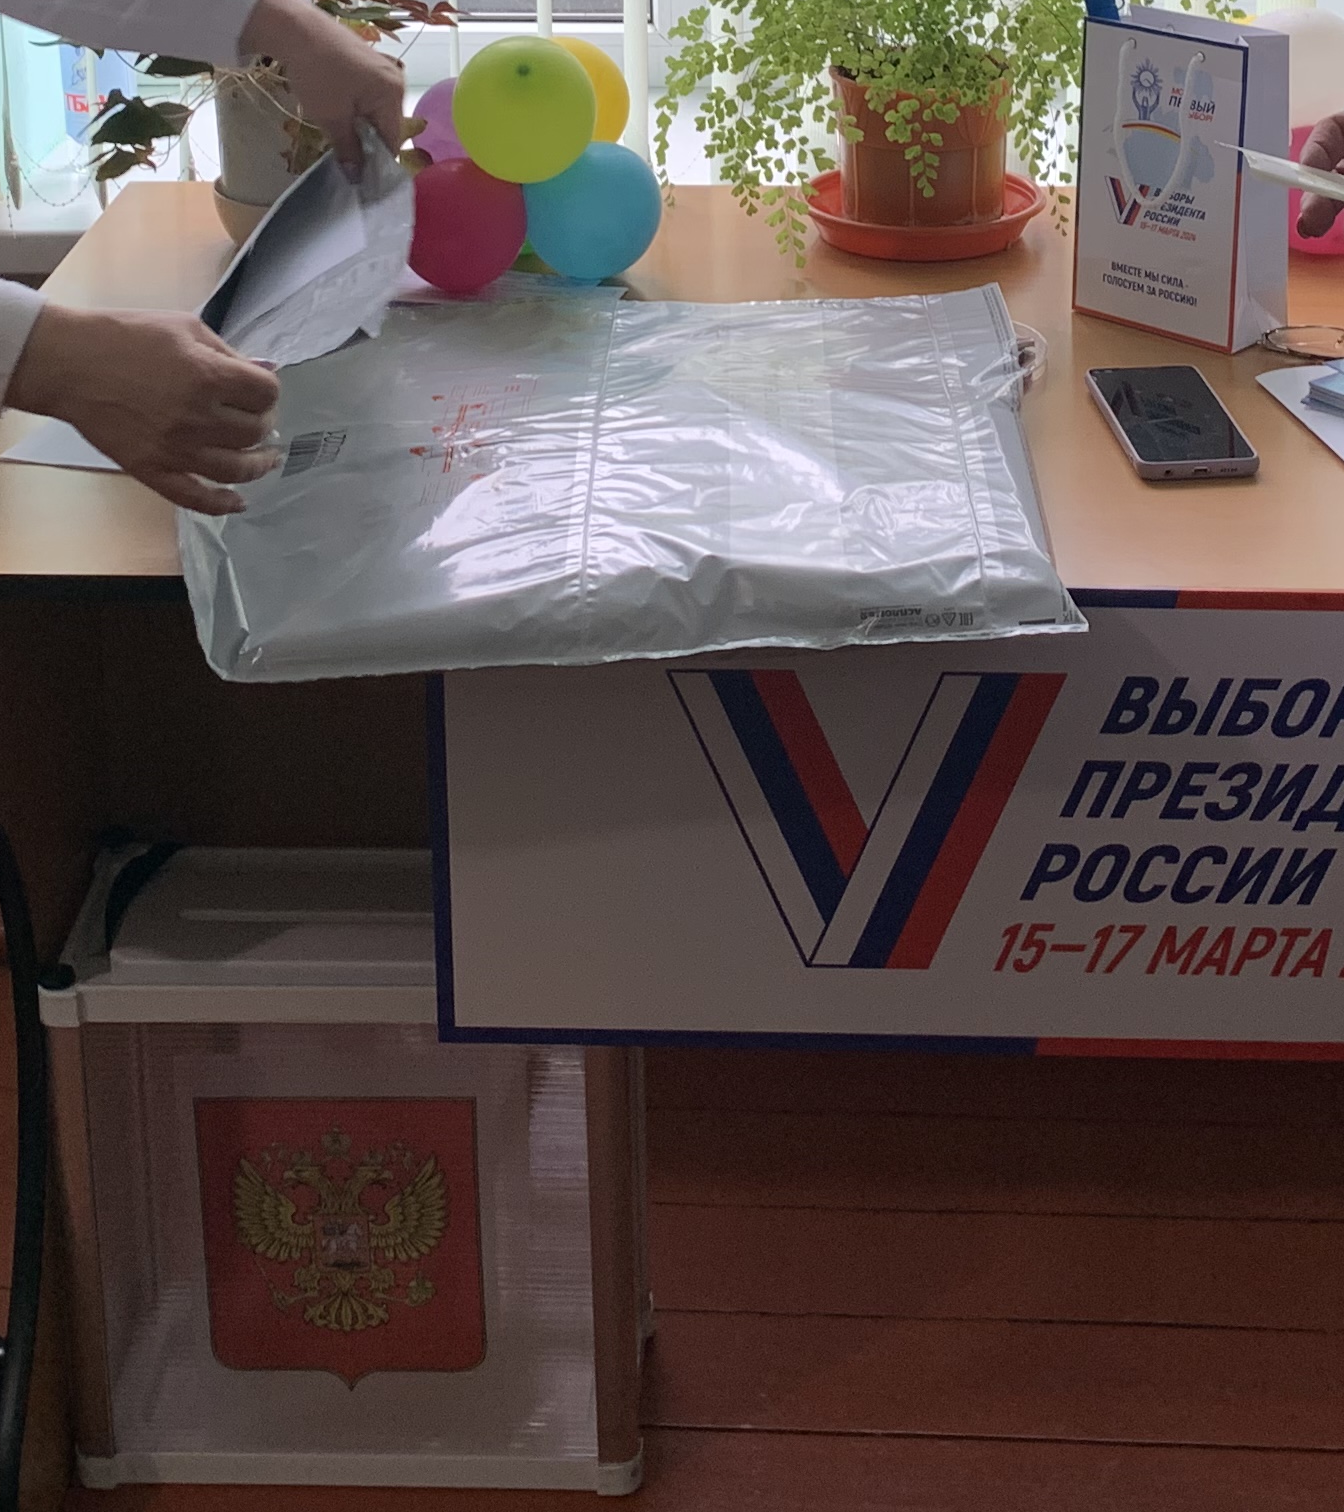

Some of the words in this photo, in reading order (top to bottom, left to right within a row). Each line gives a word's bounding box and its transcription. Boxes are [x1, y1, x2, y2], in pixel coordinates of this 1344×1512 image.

[1159, 201, 1206, 221] ЕЗИДЕНТА
[1102, 273, 1145, 293] ГОЛОСУЕМ
[1146, 284, 1157, 297] ЗА
[1158, 288, 1198, 307] РОССИЮ!
[1111, 261, 1142, 278] ВМЕСТЕ
[1144, 270, 1159, 283] МЫ
[1161, 274, 1184, 289] СИЛА
[1019, 842, 1338, 906] РОССИИ
[1145, 925, 1333, 977] МАРТА
